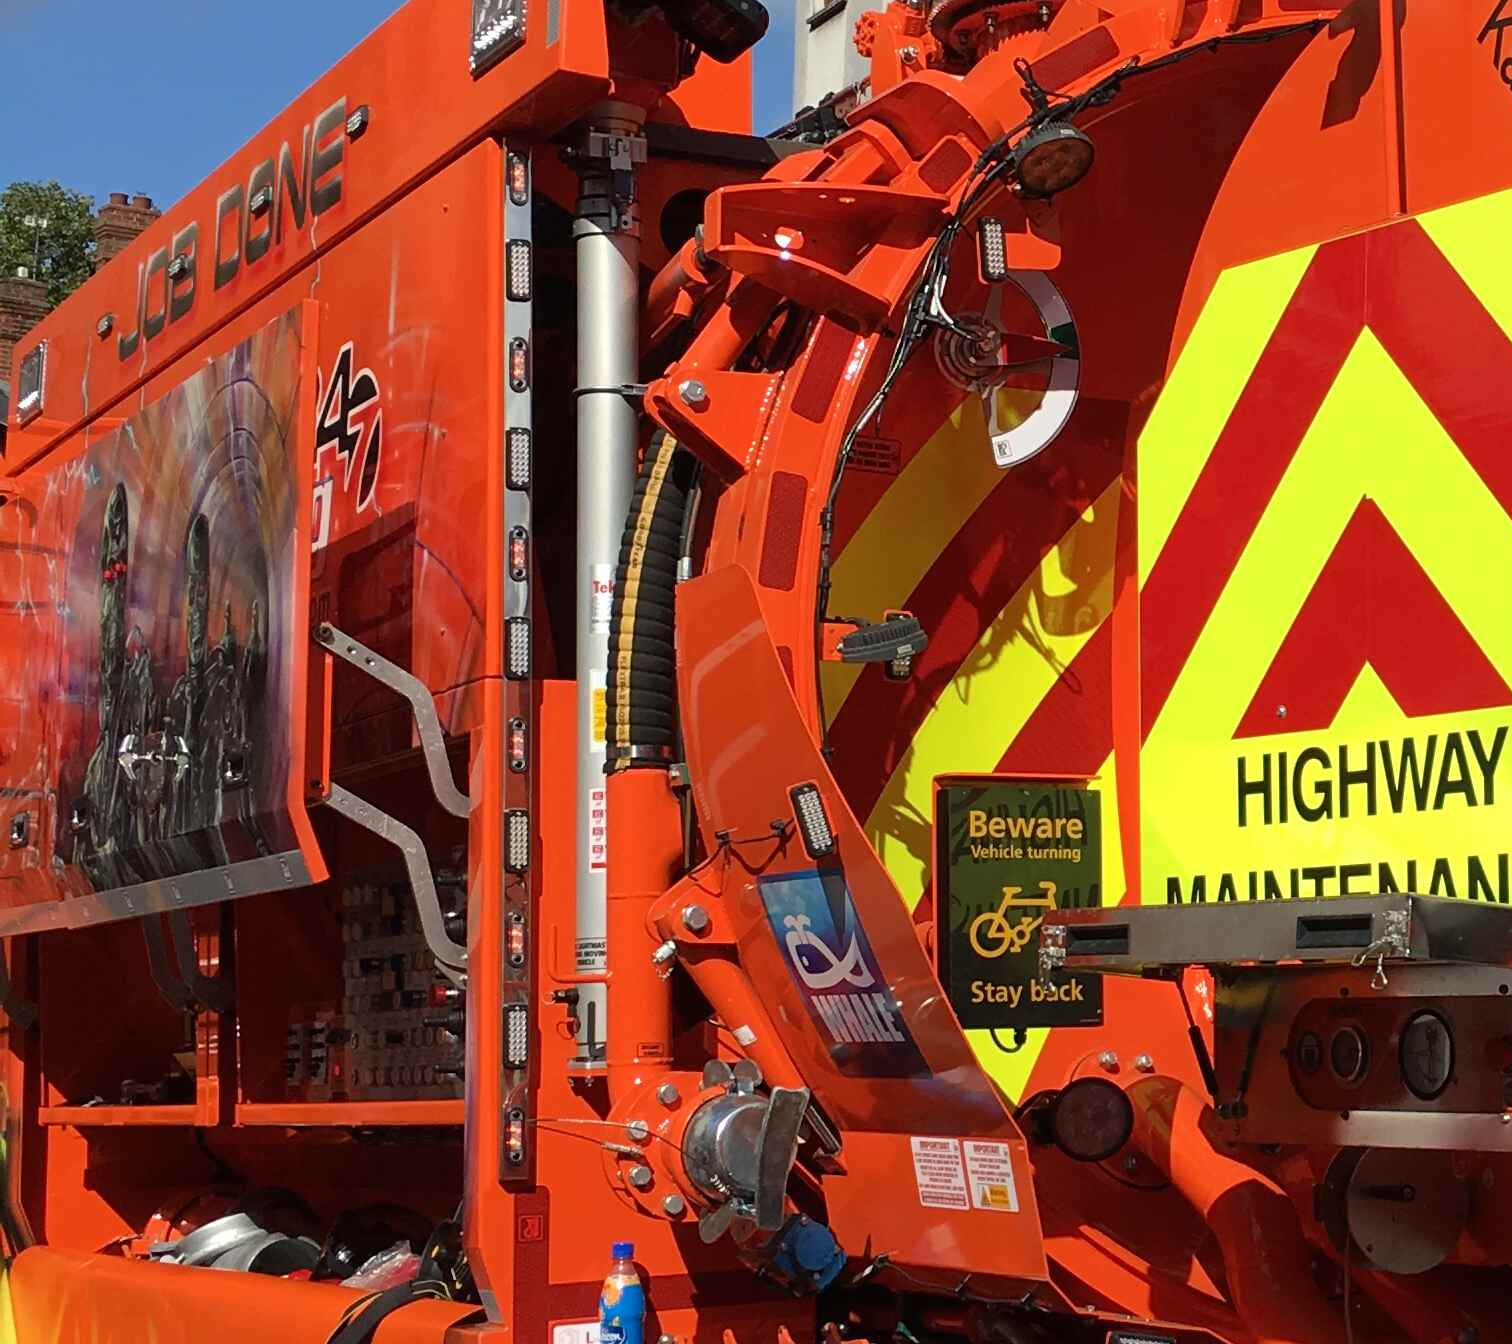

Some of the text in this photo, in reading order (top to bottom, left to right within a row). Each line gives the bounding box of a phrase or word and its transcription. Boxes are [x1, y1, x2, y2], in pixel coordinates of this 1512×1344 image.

[117, 95, 347, 362] JOB DONE
[1237, 725, 1510, 828] HIGHWAY
[969, 810, 1084, 839] Beware
[971, 844, 1081, 864] Vehicle turning
[971, 979, 1084, 1008] Stay back
[811, 993, 906, 1043] WHALE
